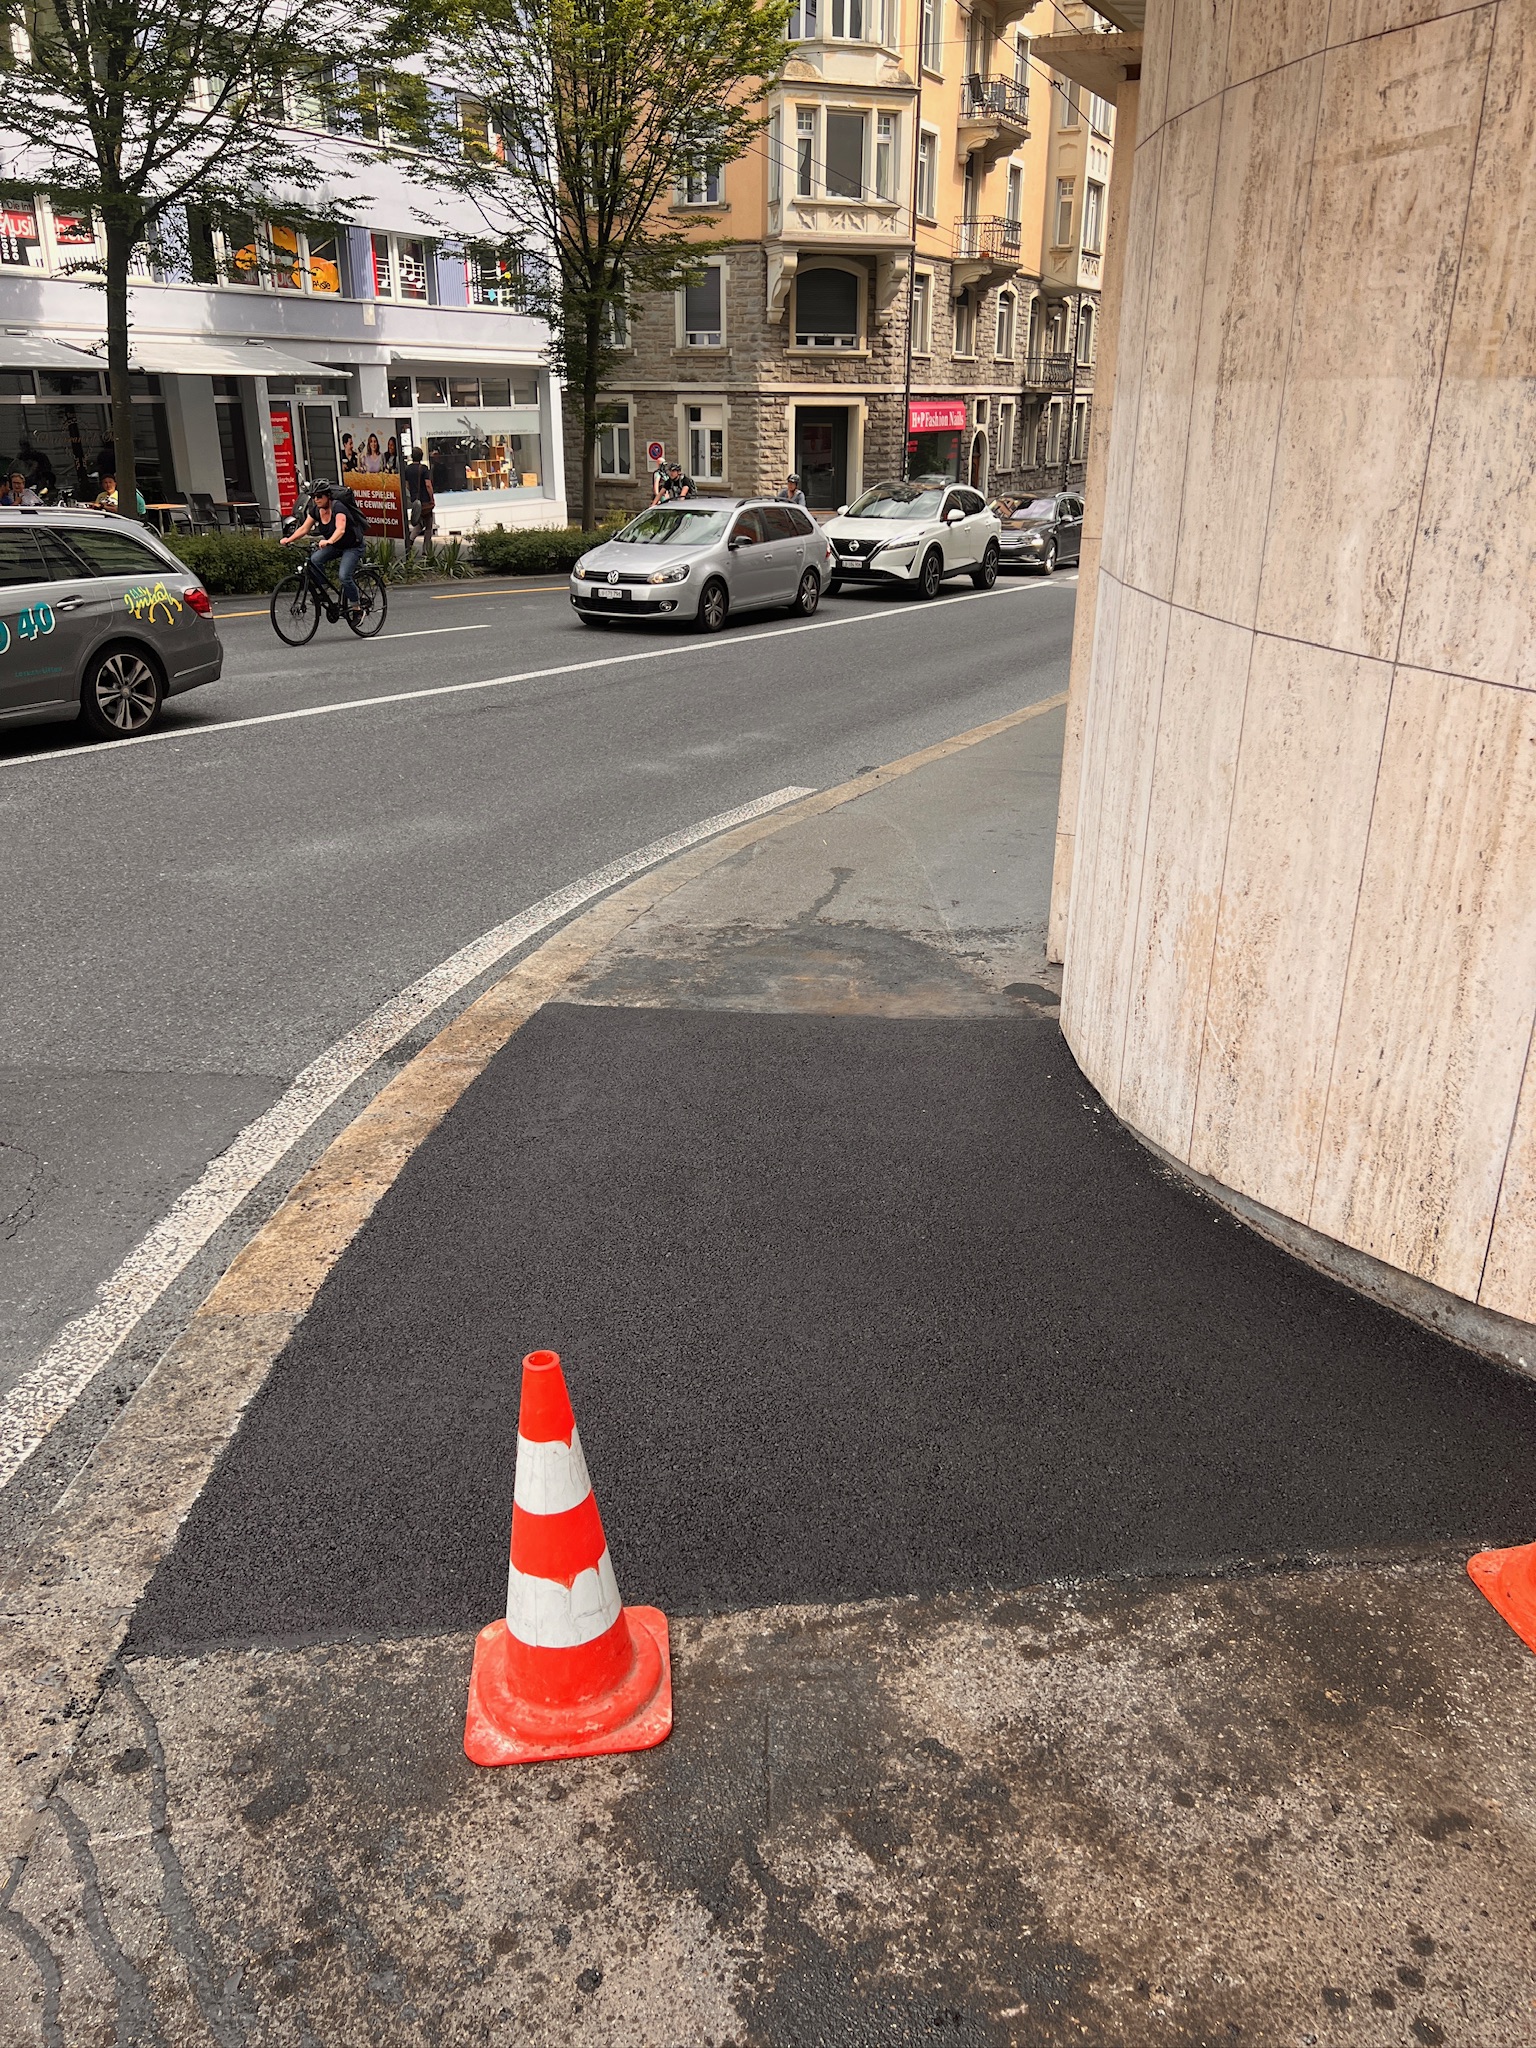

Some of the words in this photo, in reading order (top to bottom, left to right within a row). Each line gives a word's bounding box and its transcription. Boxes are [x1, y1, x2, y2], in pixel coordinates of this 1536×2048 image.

[925, 411, 948, 427] Fashion
[949, 410, 964, 426] Nails
[353, 490, 371, 498] NLINE
[18, 602, 56, 641] 40
